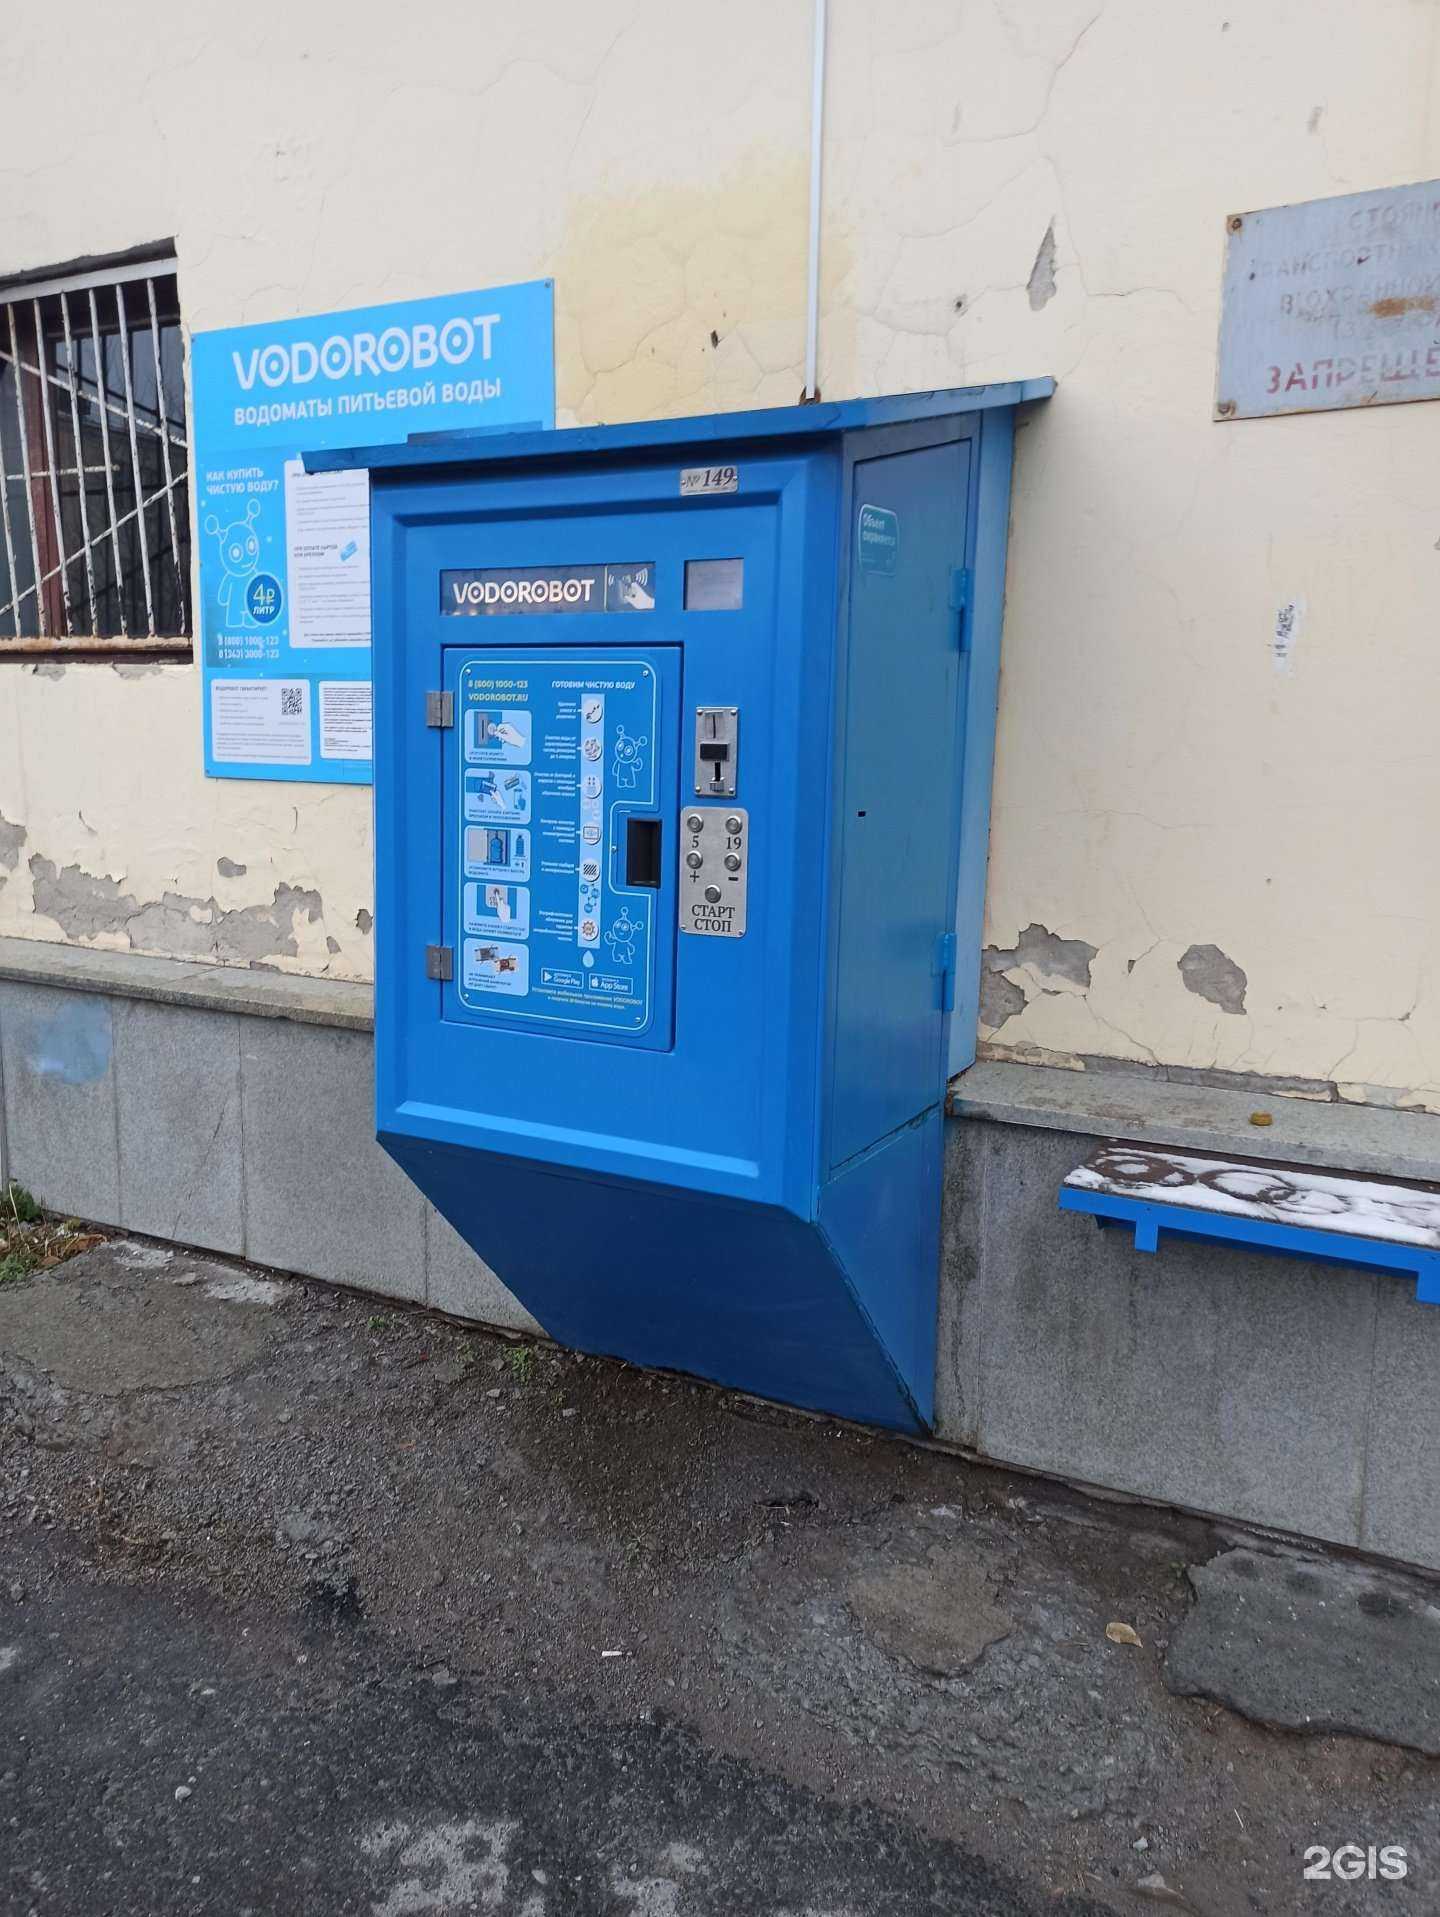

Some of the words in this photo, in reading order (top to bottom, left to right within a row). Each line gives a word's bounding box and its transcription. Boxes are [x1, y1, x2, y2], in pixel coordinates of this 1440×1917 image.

[232, 314, 500, 390] VODOROBOT
[234, 399, 332, 427] ВОДОМАТЫ
[337, 381, 436, 415] ПИТЬЕВОЙ
[441, 378, 501, 403] ВОДЫ
[206, 470, 224, 482] КАК
[226, 467, 264, 480] КУПИТЬ
[702, 467, 735, 487] 149
[207, 482, 246, 495] ЧИСТУЮ
[247, 480, 279, 494] ВОДУ?
[453, 579, 595, 604] VODOROBOT
[252, 605, 275, 616] ЛИТР
[551, 680, 584, 689] ГОТОВИМ
[584, 680, 615, 689] ЧИСТУЮ
[615, 680, 636, 690] ВОДУ
[468, 692, 529, 702] VODOROBOT.RU
[691, 835, 699, 848] 5
[726, 836, 742, 850] 19
[691, 904, 736, 919] СТАРТ
[693, 918, 732, 933] СТОП
[553, 976, 570, 985] Google
[570, 977, 581, 986] Play
[600, 981, 612, 990] App
[612, 982, 629, 991] Store
